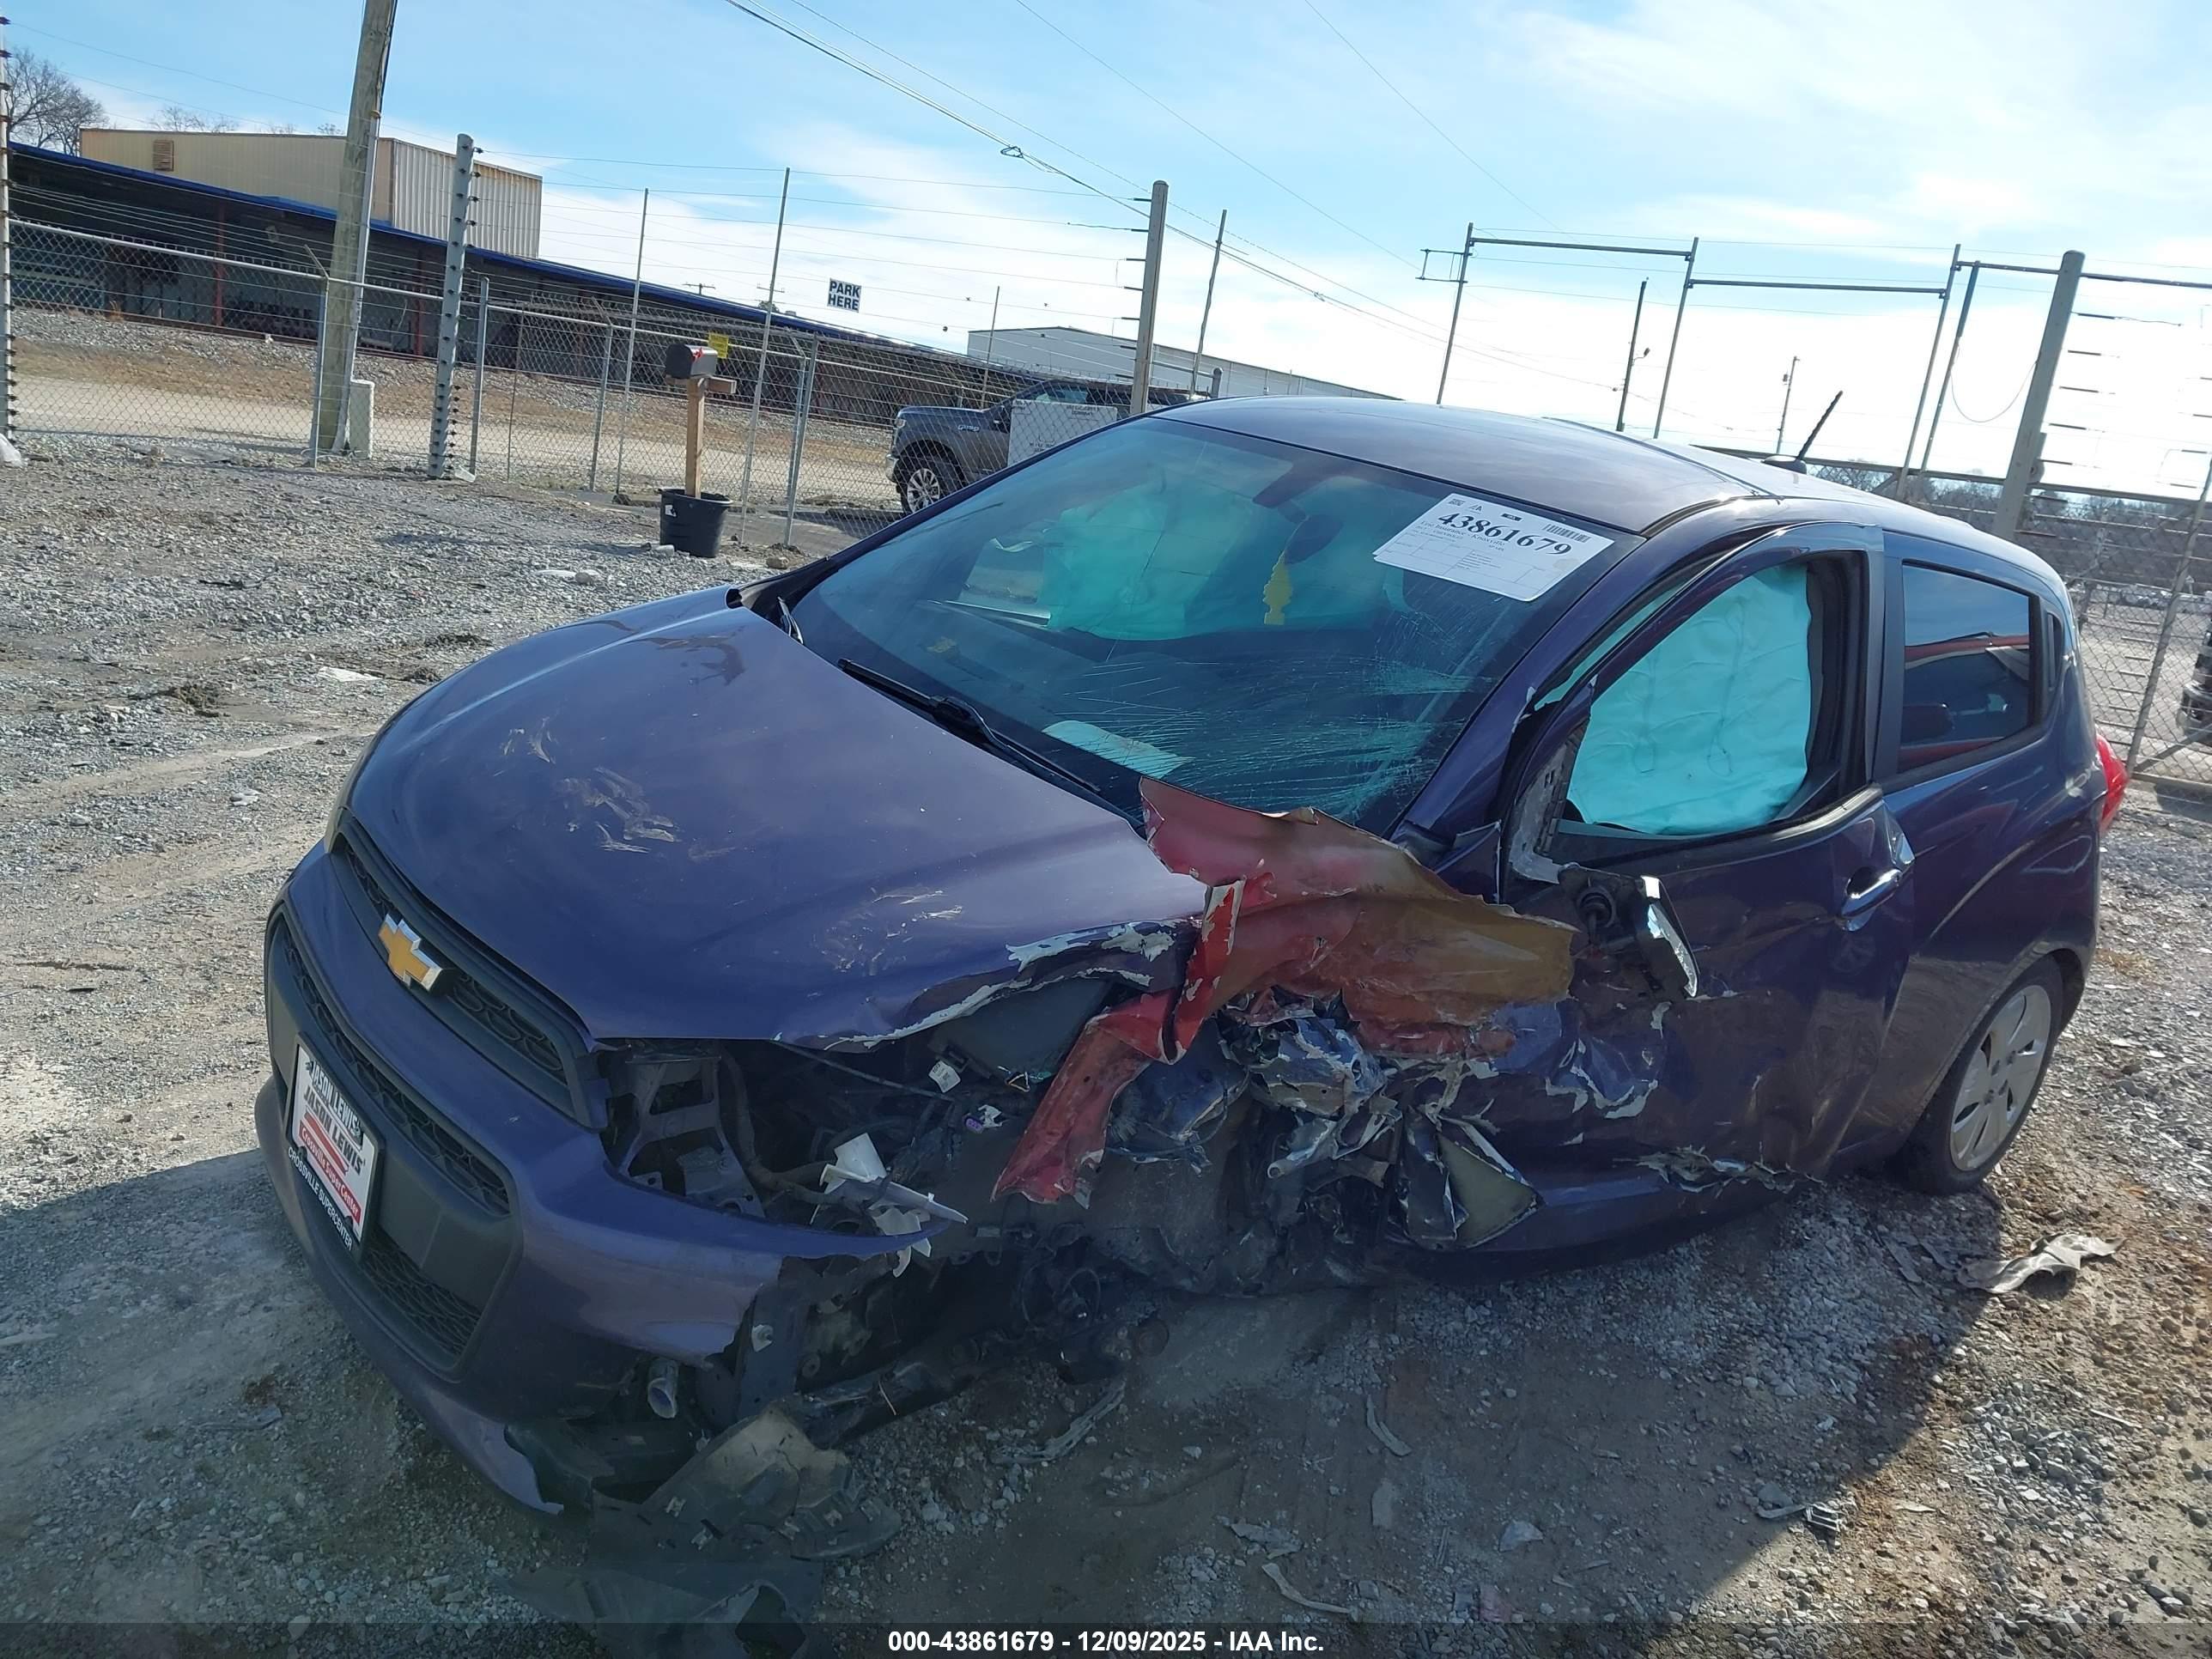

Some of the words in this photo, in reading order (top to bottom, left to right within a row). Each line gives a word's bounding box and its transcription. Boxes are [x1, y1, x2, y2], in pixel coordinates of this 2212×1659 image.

[828, 293, 860, 311] HERE
[830, 281, 860, 298] PARK
[1437, 513, 1573, 555] 43861679
[310, 1060, 334, 1105] JASON
[304, 1085, 333, 1133] JASON
[301, 1127, 326, 1169] Crossville
[288, 1146, 319, 1195] CROSSVILLE
[318, 1188, 353, 1251] SUPERCENTER
